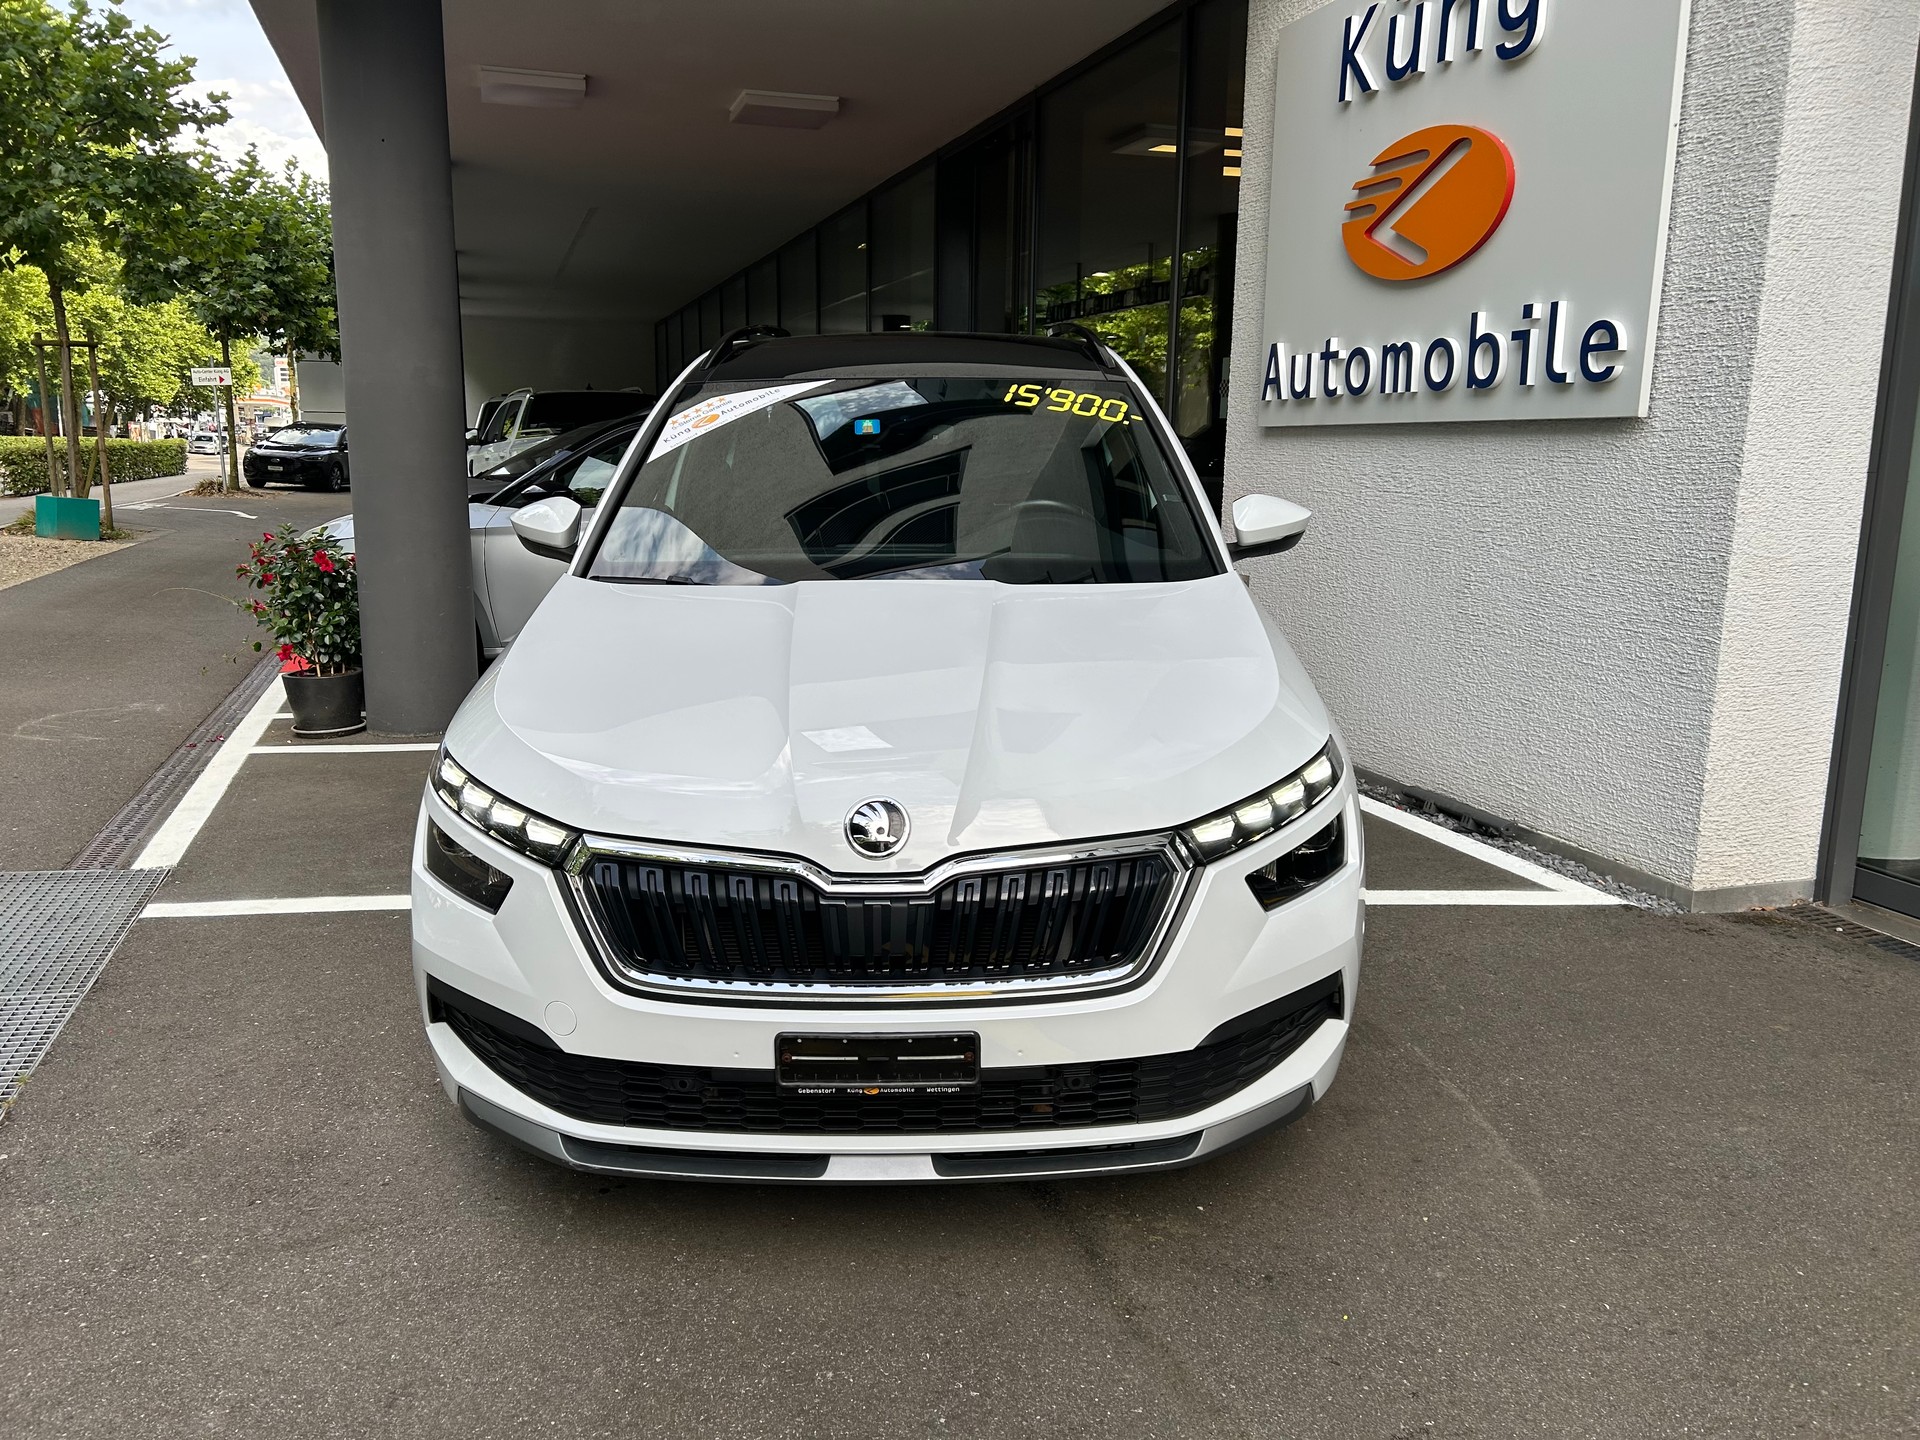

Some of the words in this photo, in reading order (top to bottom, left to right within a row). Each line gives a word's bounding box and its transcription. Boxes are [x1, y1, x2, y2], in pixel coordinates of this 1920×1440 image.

[1262, 300, 1627, 401] Automobile
[663, 427, 692, 443] Küng
[721, 388, 780, 416] Automobile
[1004, 384, 1143, 425] 15'900.-
